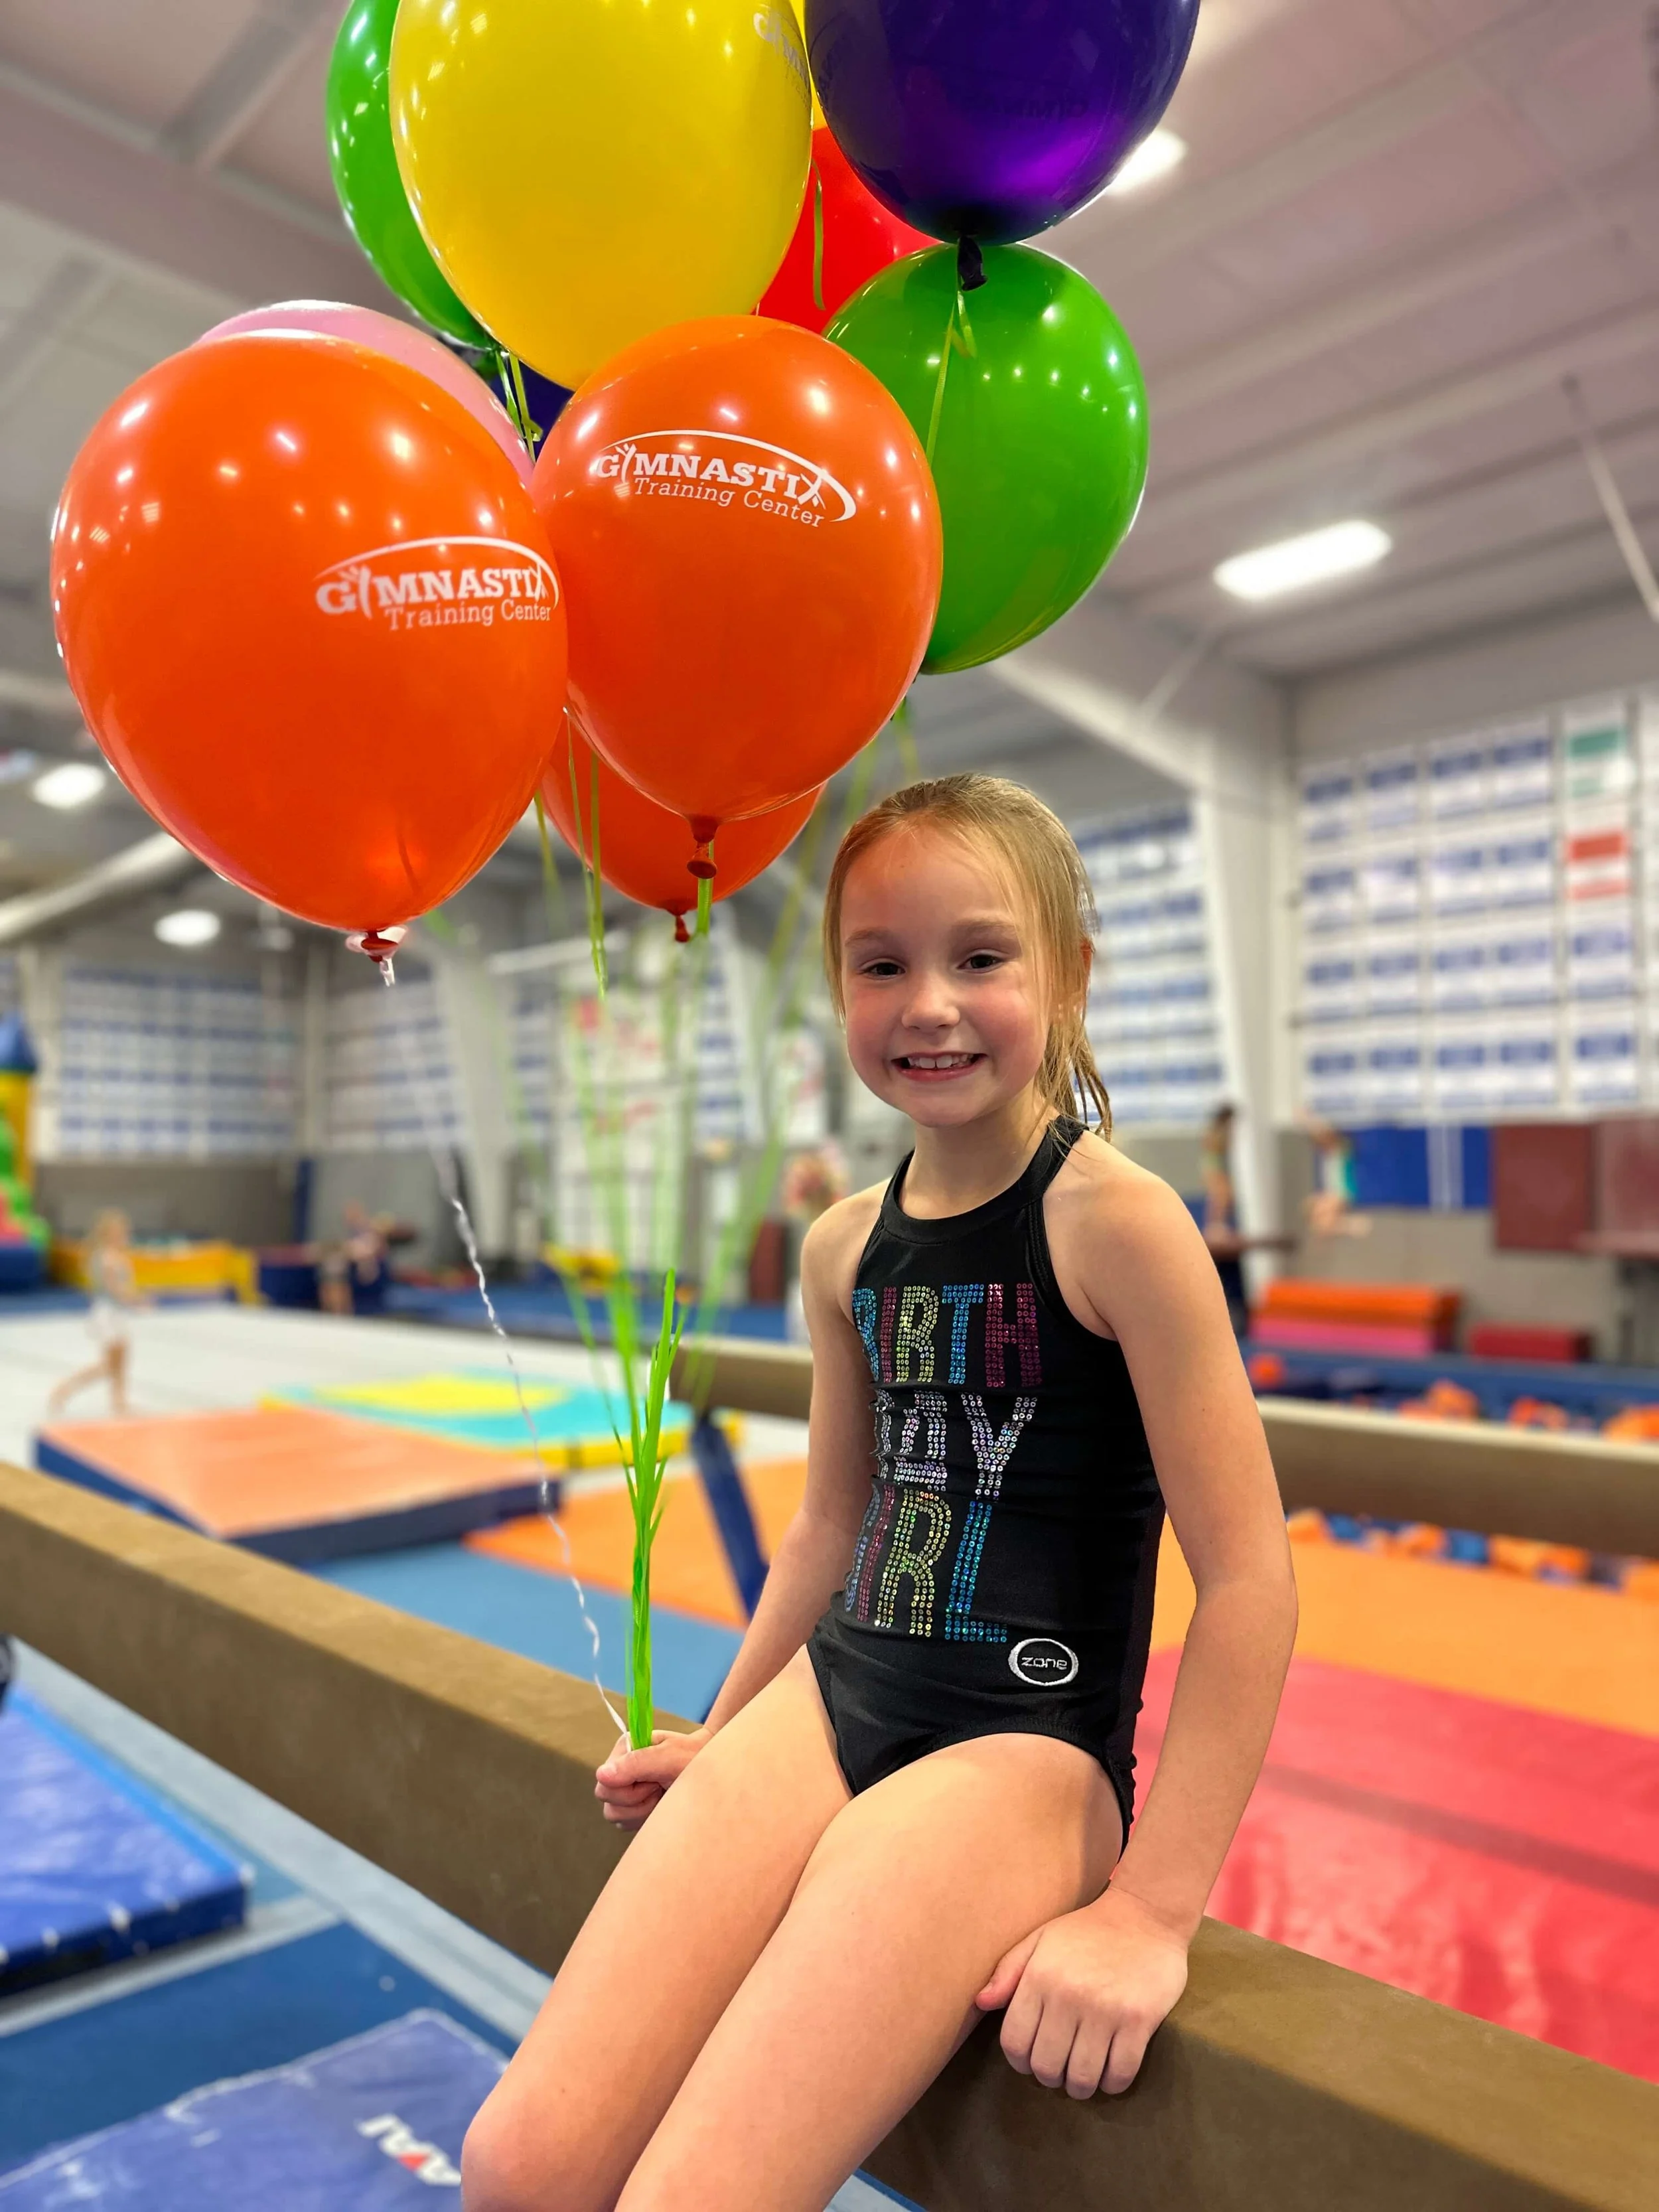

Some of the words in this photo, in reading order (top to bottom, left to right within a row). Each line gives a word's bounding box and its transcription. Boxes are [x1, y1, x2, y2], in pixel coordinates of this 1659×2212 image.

[595, 443, 826, 510] GYMNASTIX
[633, 477, 736, 507] Training
[743, 489, 825, 528] Center
[384, 601, 495, 631] Training
[500, 599, 551, 621] Center
